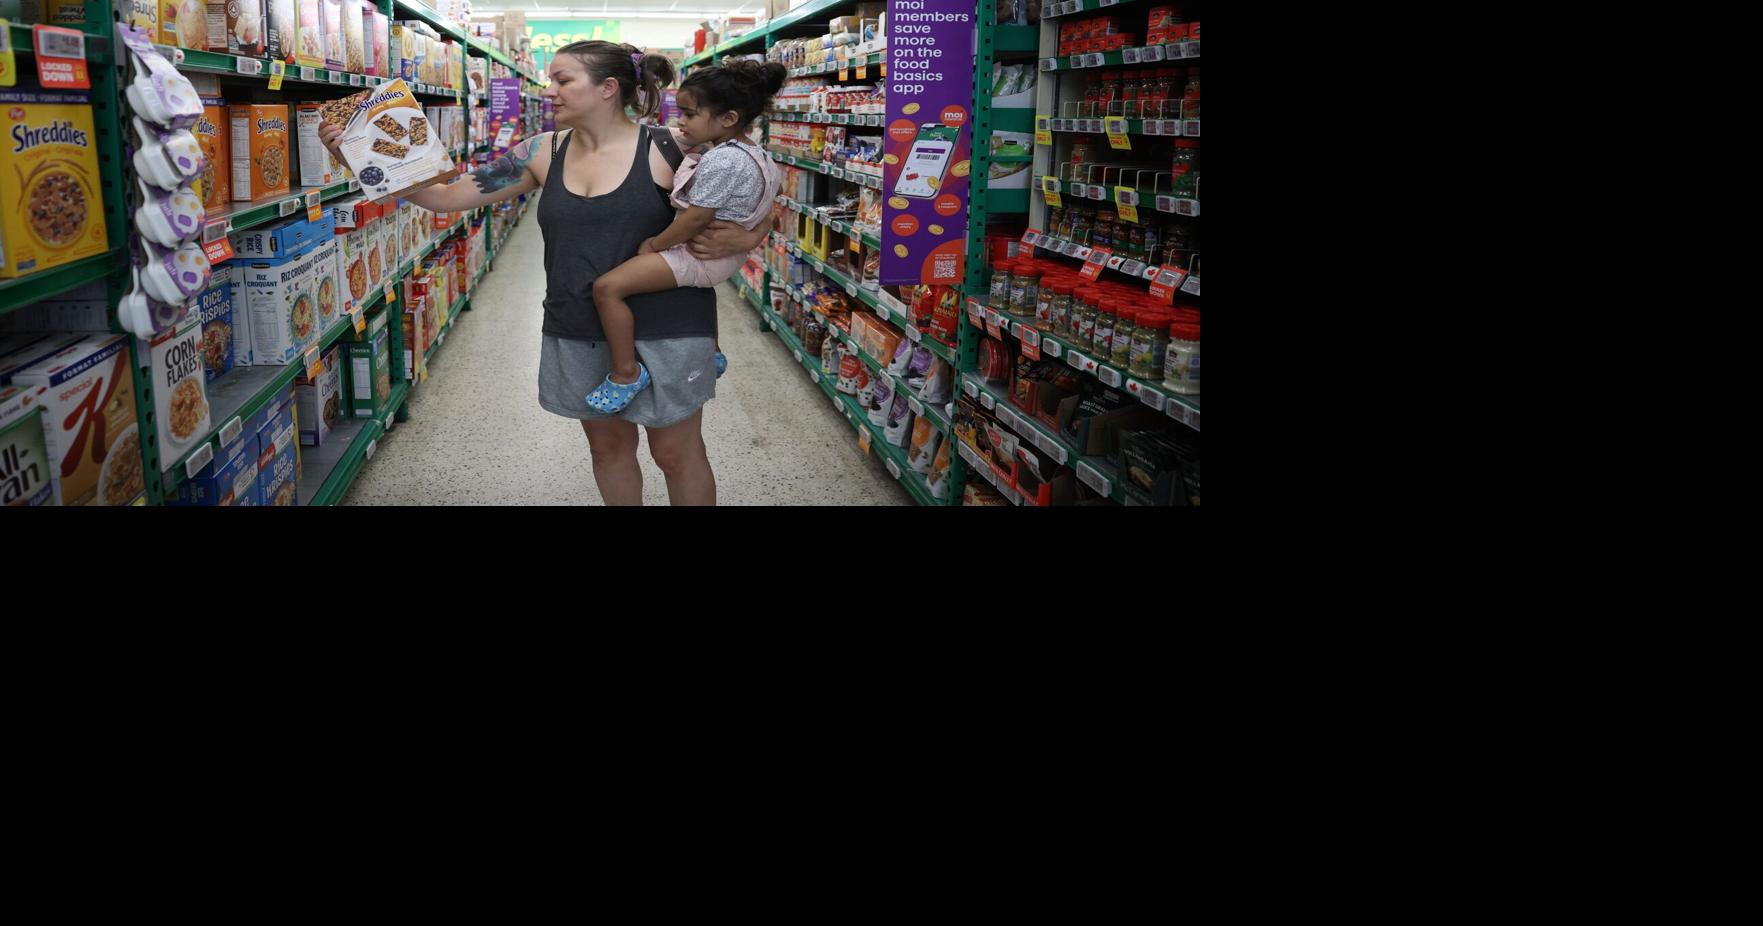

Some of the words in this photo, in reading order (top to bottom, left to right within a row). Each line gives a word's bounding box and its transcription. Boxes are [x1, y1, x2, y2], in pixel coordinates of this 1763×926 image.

[895, 0, 924, 10] moi
[895, 11, 969, 22] members
[894, 25, 931, 34] save
[894, 36, 936, 46] more
[894, 48, 914, 58] on
[917, 47, 943, 58] the
[893, 58, 930, 69] food
[42, 72, 75, 82] DOWN
[893, 70, 943, 81] basics
[893, 84, 925, 95] app
[360, 90, 405, 112] Shreddies
[944, 111, 963, 119] moi
[257, 117, 286, 134] Shreddies
[12, 120, 88, 152] Shreddies
[281, 270, 291, 283] RIZ
[246, 281, 278, 289] CROQUANT
[165, 335, 196, 369] CORN
[62, 360, 93, 380] FORMAT
[166, 355, 198, 387] FLAKES
